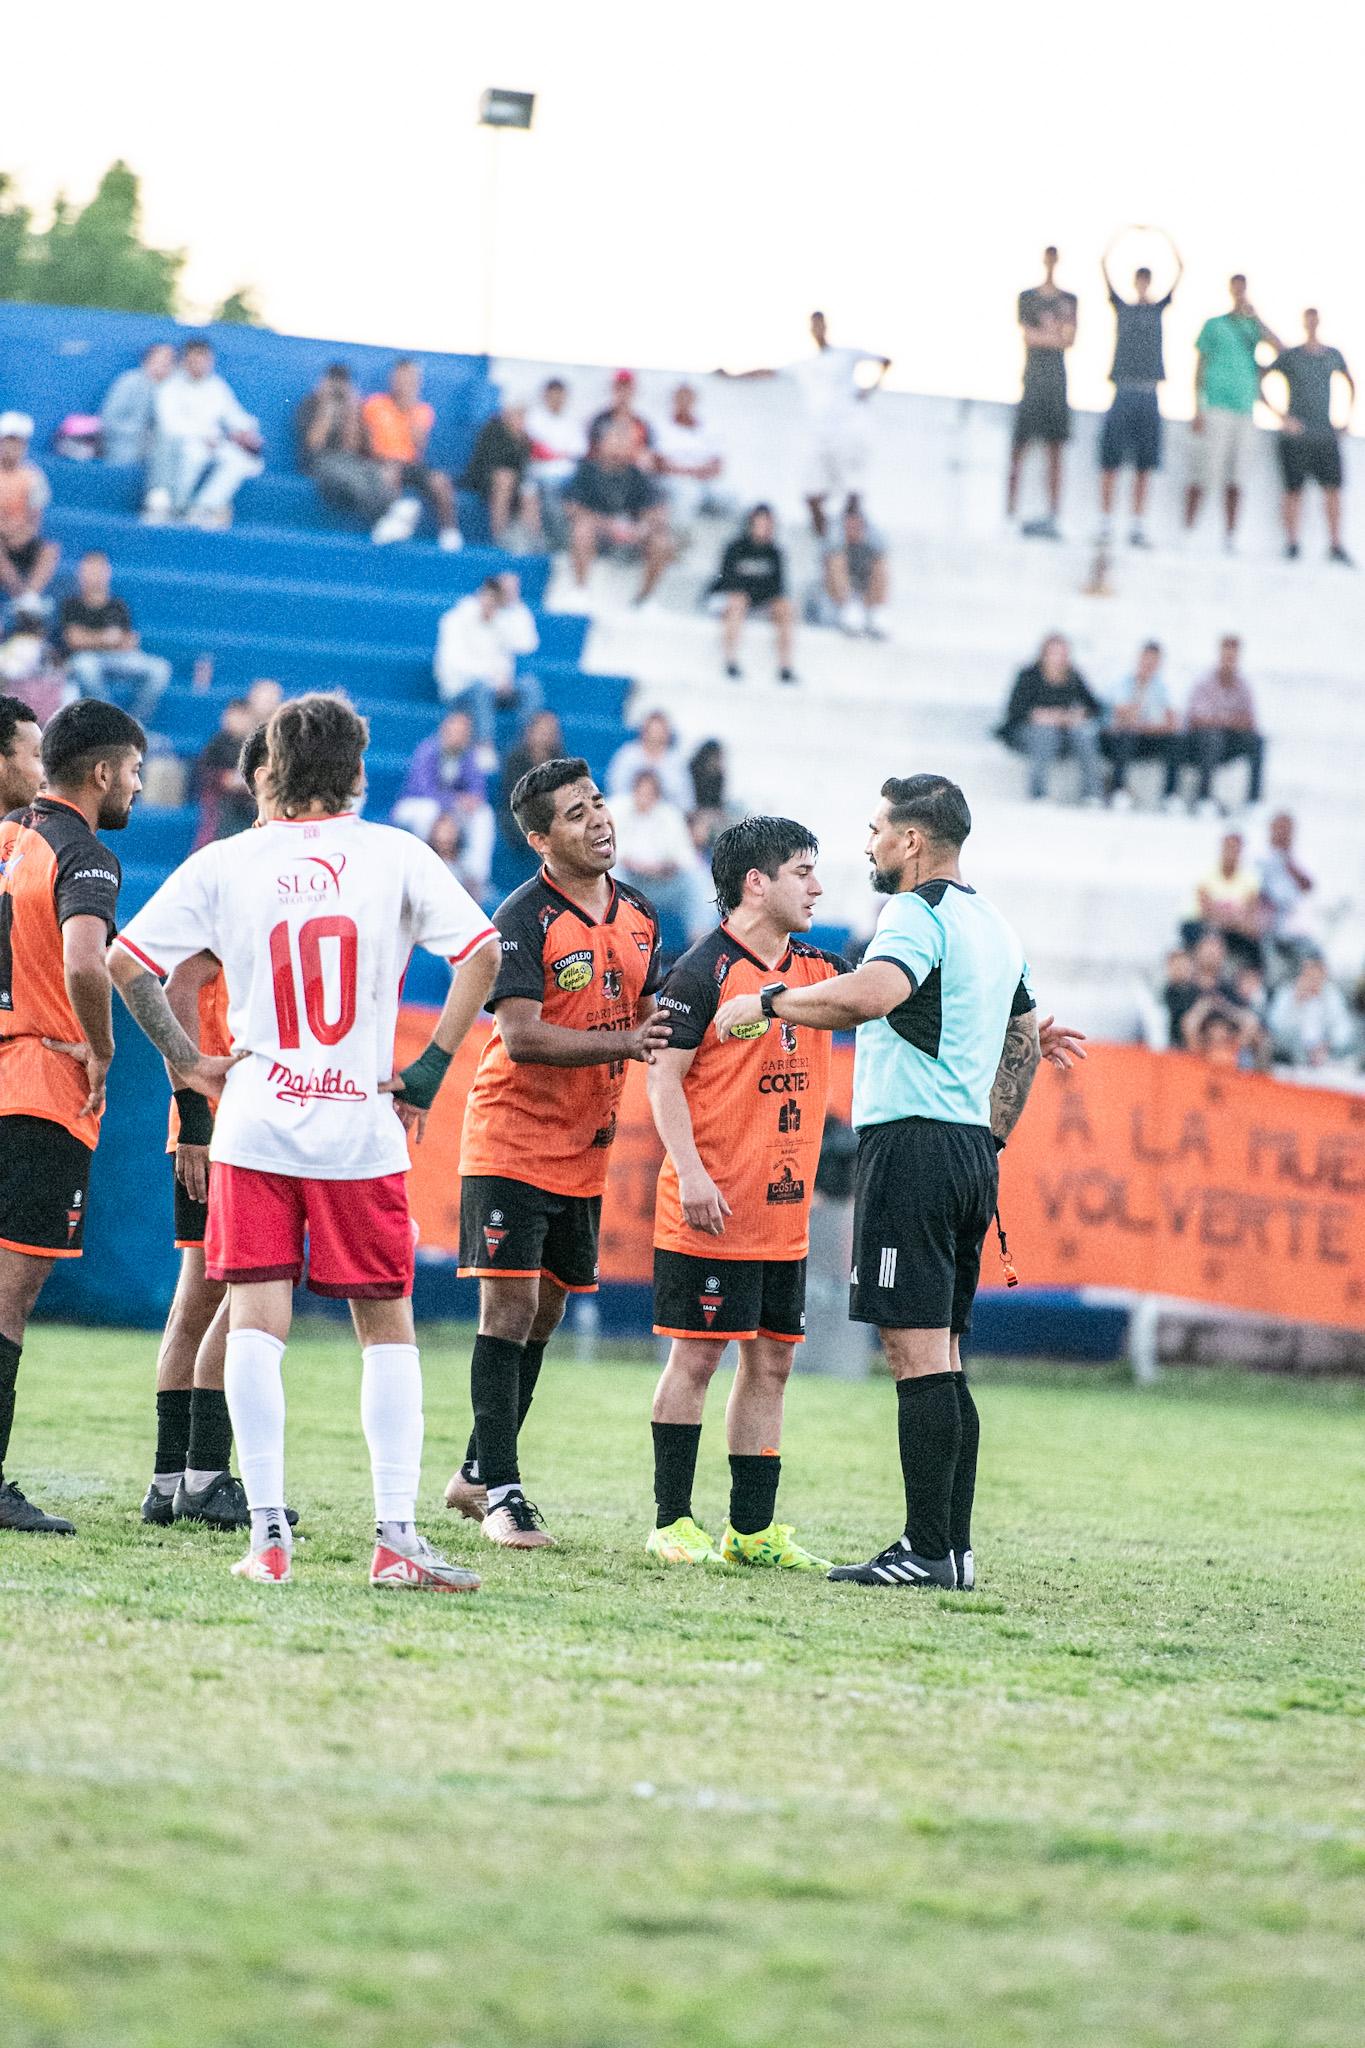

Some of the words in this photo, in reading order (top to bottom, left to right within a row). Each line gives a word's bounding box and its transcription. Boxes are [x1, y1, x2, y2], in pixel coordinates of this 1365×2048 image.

[277, 873, 327, 894] SLG
[554, 951, 592, 970] COMPLEJO
[269, 915, 358, 1050] 10
[267, 1062, 367, 1106] Mafalda
[1129, 1103, 1213, 1168] LA
[772, 1181, 801, 1193] COSTA
